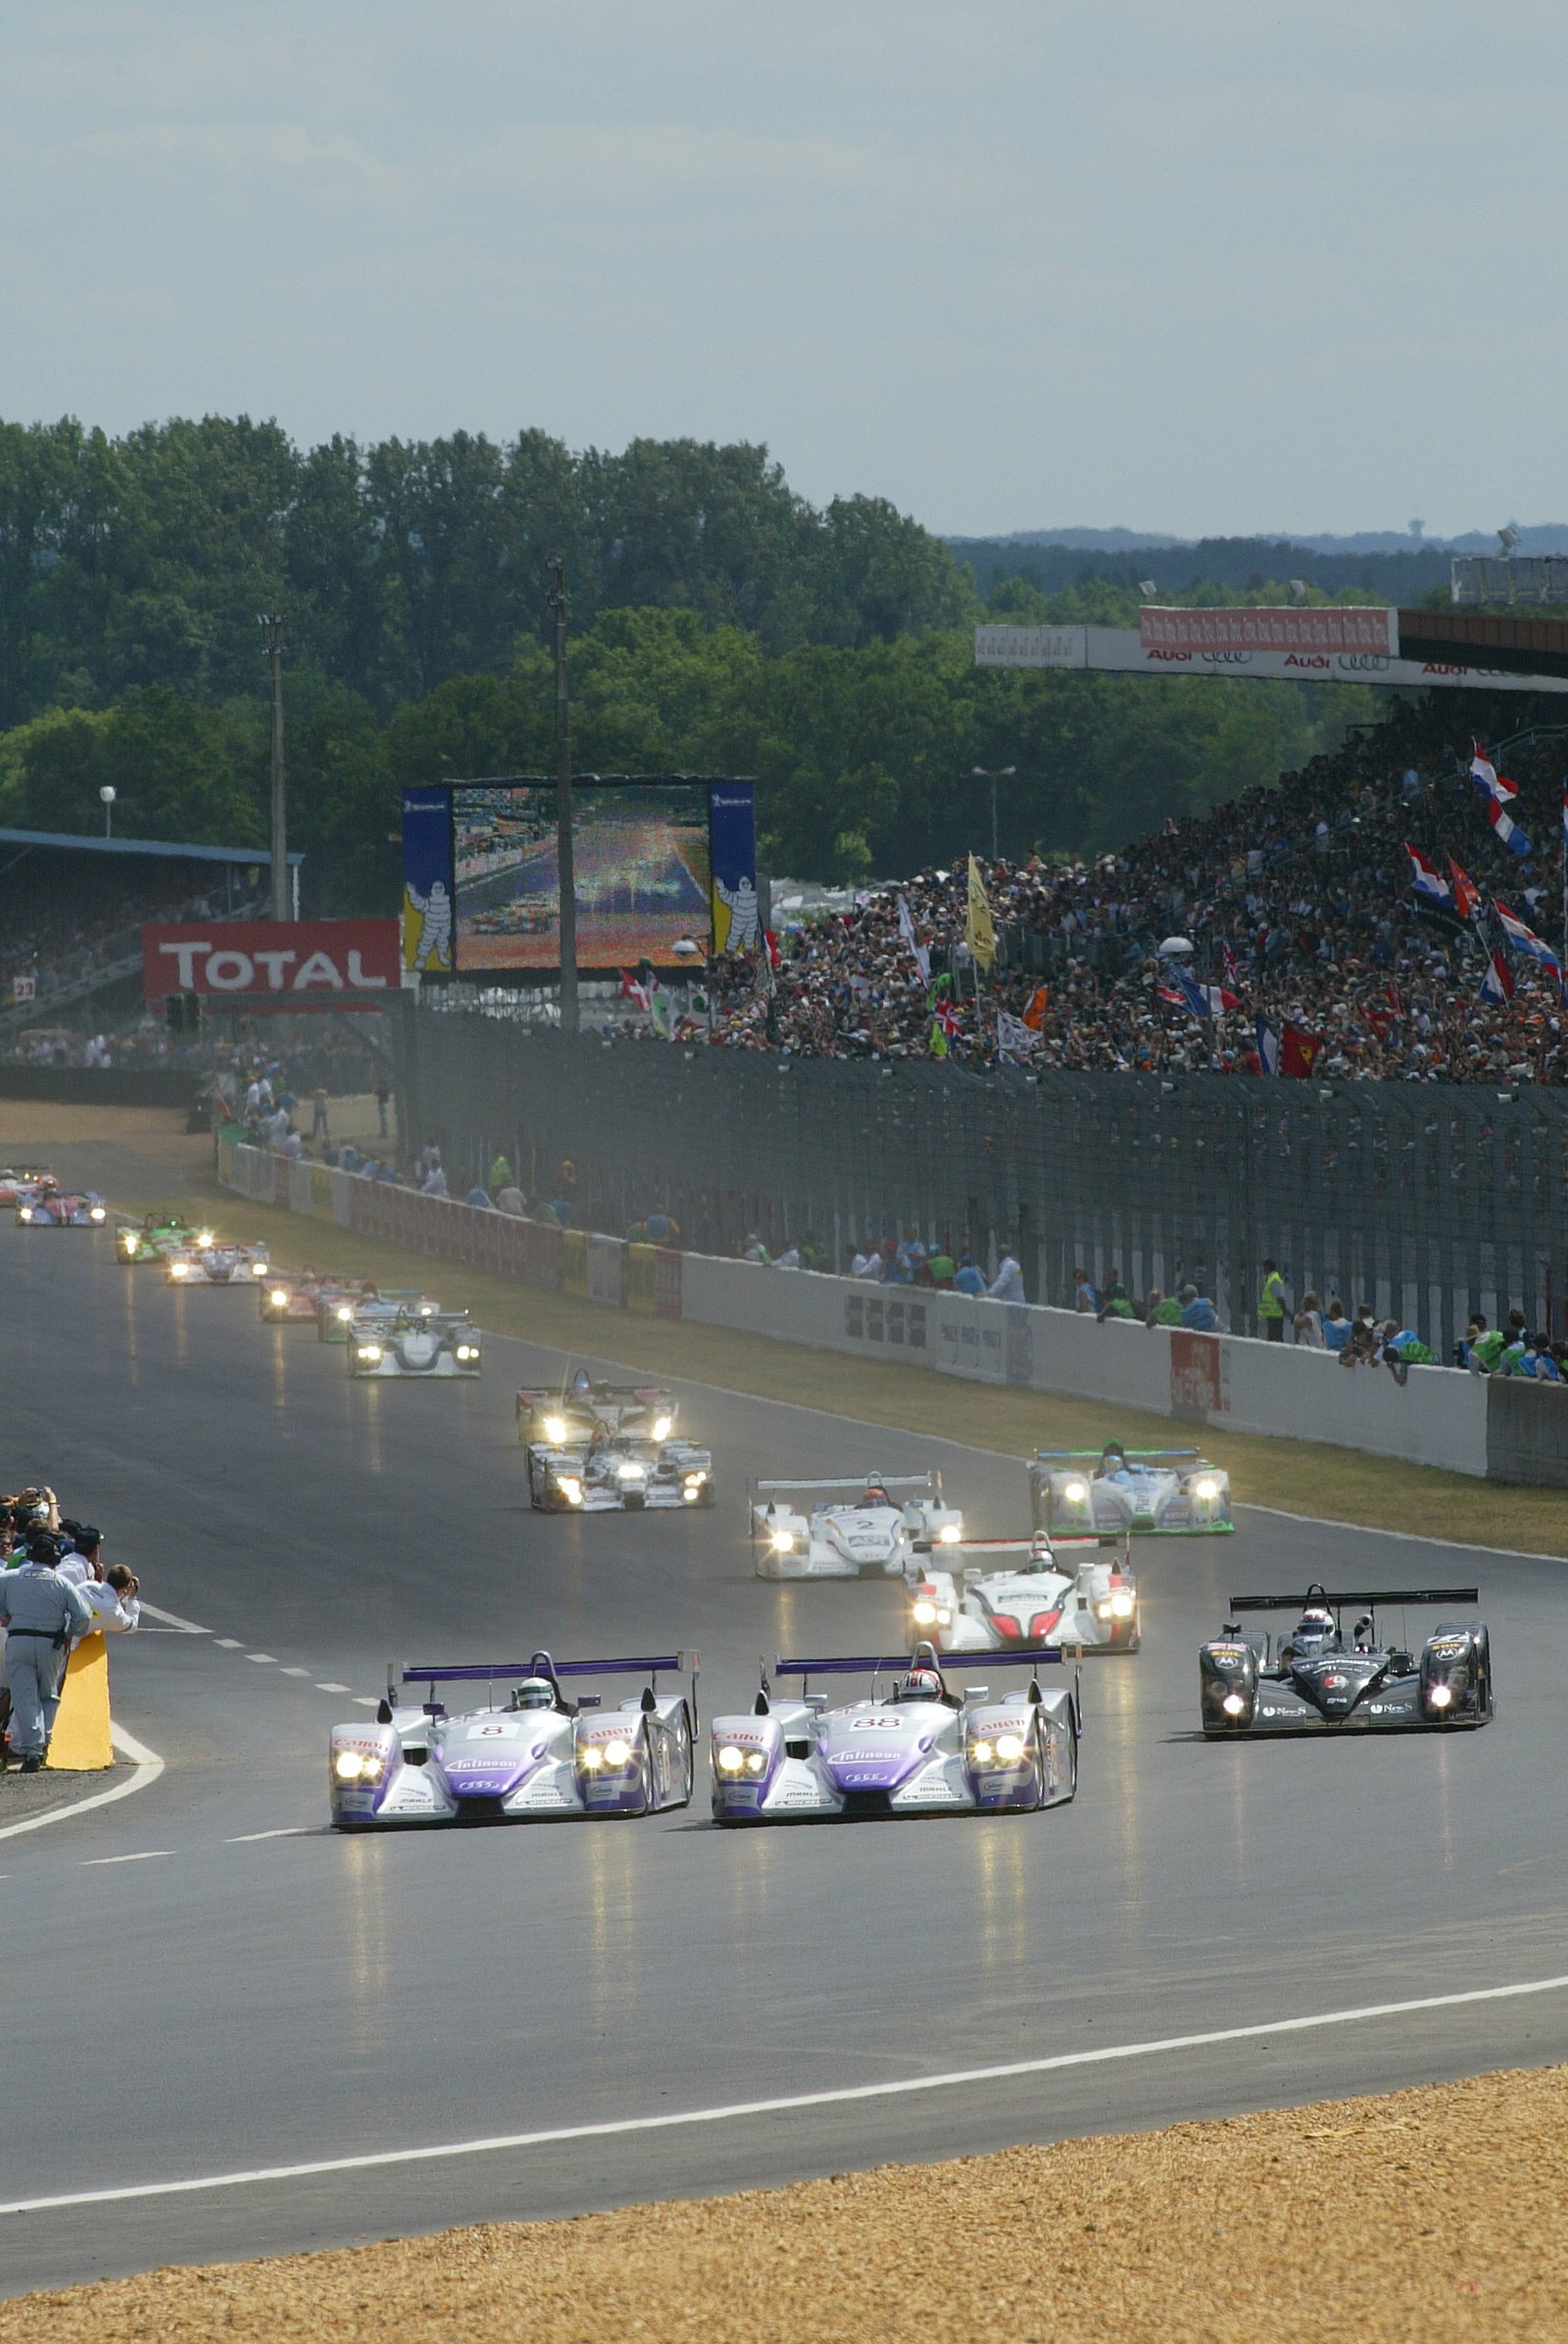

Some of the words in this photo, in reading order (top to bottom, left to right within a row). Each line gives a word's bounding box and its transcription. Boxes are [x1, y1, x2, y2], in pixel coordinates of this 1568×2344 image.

[1284, 654, 1330, 668] Audi
[159, 941, 387, 990] TOTAL
[856, 1520, 876, 1530] 2
[854, 1717, 901, 1728] 88
[481, 1726, 504, 1735] 8
